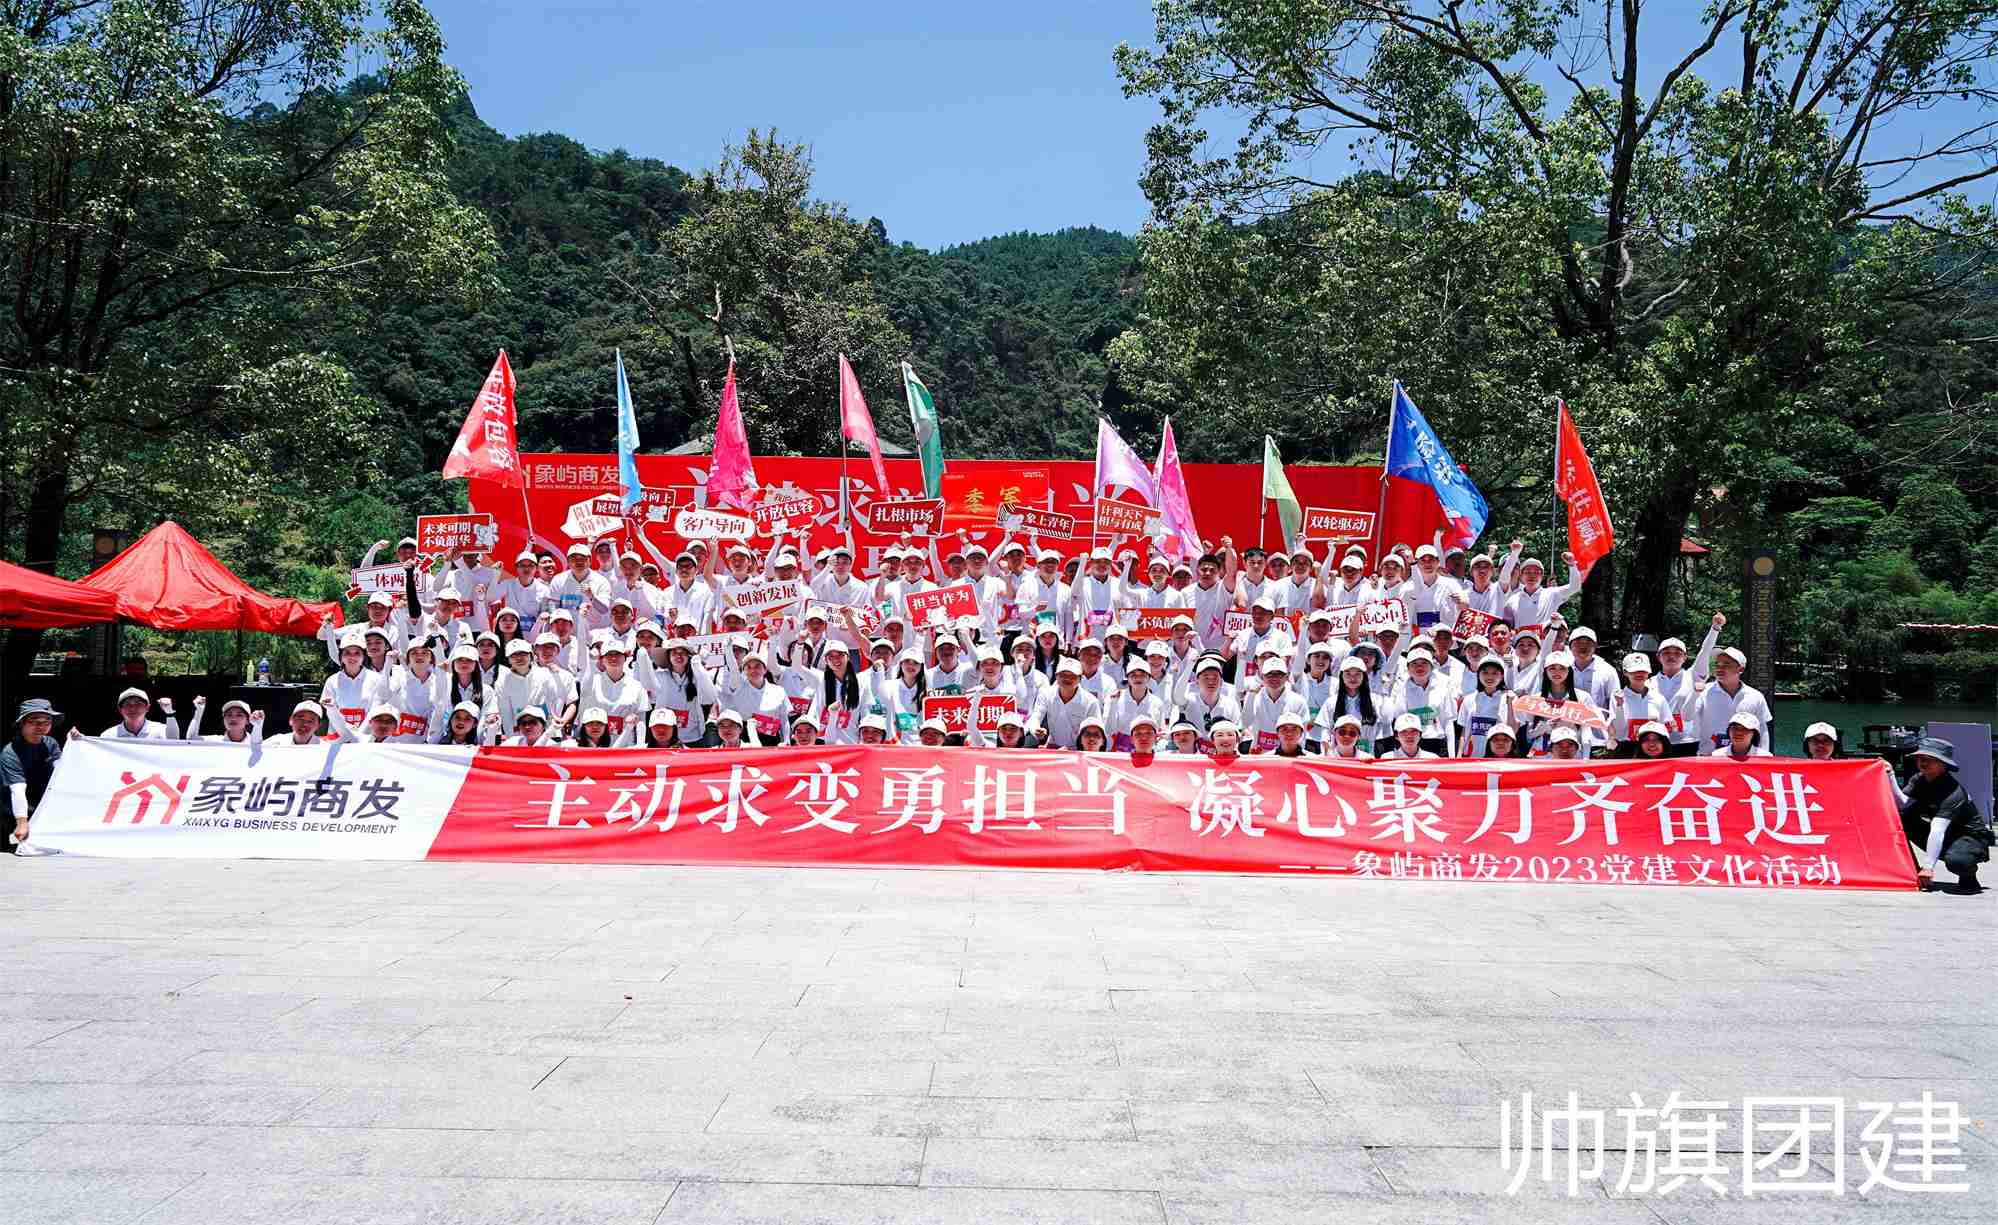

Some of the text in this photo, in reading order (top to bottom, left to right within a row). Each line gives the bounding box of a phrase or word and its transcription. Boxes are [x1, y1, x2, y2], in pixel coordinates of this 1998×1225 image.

[535, 465, 620, 485] 象屿商发
[595, 500, 642, 517] 展望来
[755, 501, 814, 524] 开放包容
[875, 507, 934, 525] 扎根市场
[424, 522, 471, 535] 未来可期
[683, 516, 745, 534] 客户导向
[1026, 512, 1071, 530] 象上青年
[1311, 515, 1367, 532] 双轮驱动
[424, 534, 471, 547] 不负韶华
[737, 584, 797, 607] 创新发展
[911, 589, 969, 610] 担当作为
[188, 776, 404, 820] 象屿商发
[514, 762, 1830, 847] 主动求变勇担当 凝心聚力齐奋进
[183, 816, 397, 835] XMXYG BUSINESS DEVELOPMENT
